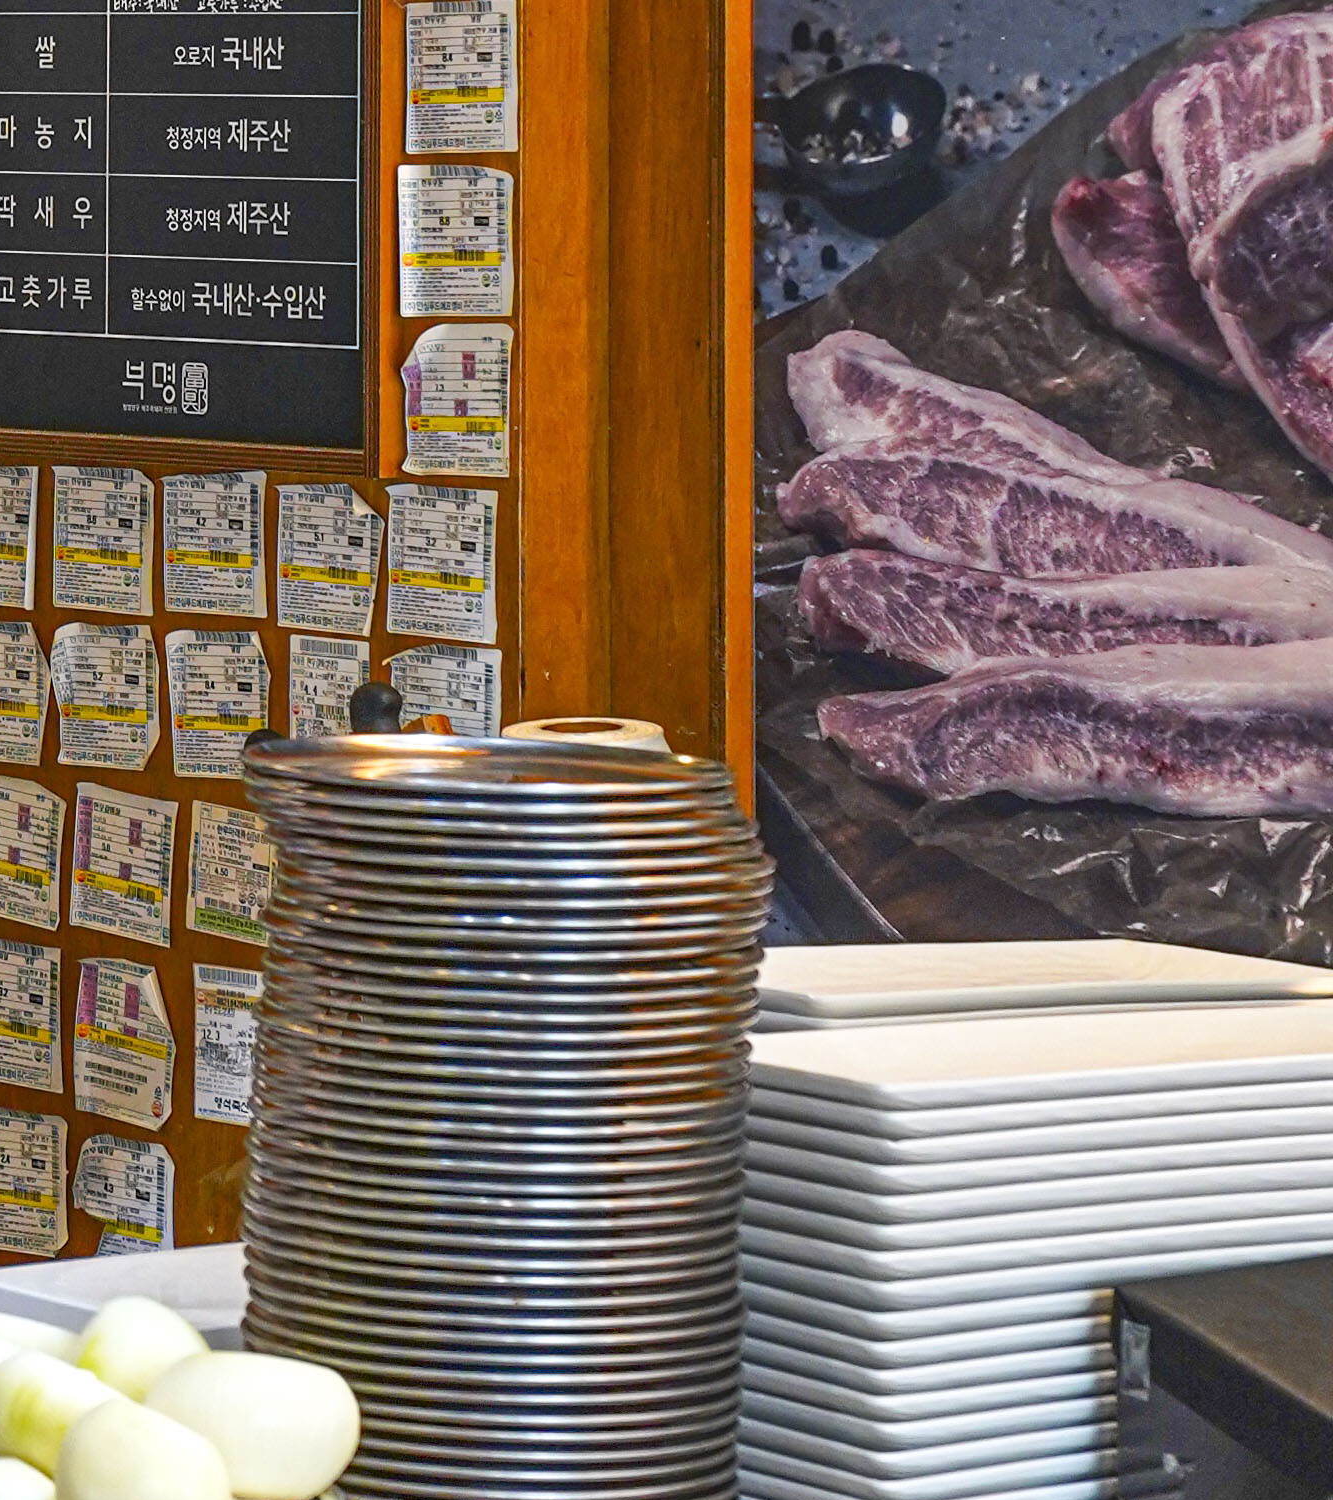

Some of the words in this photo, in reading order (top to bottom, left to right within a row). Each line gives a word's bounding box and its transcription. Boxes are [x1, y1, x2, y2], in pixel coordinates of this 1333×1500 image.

[35, 35, 56, 69] 쌀
[173, 46, 216, 68] 오로지
[221, 36, 285, 71] 국내산
[166, 126, 221, 152] 청정지역
[227, 118, 291, 153] 제주산
[165, 207, 221, 233] 청정지역
[227, 201, 291, 236] 제주산
[131, 287, 186, 313] 할수없이
